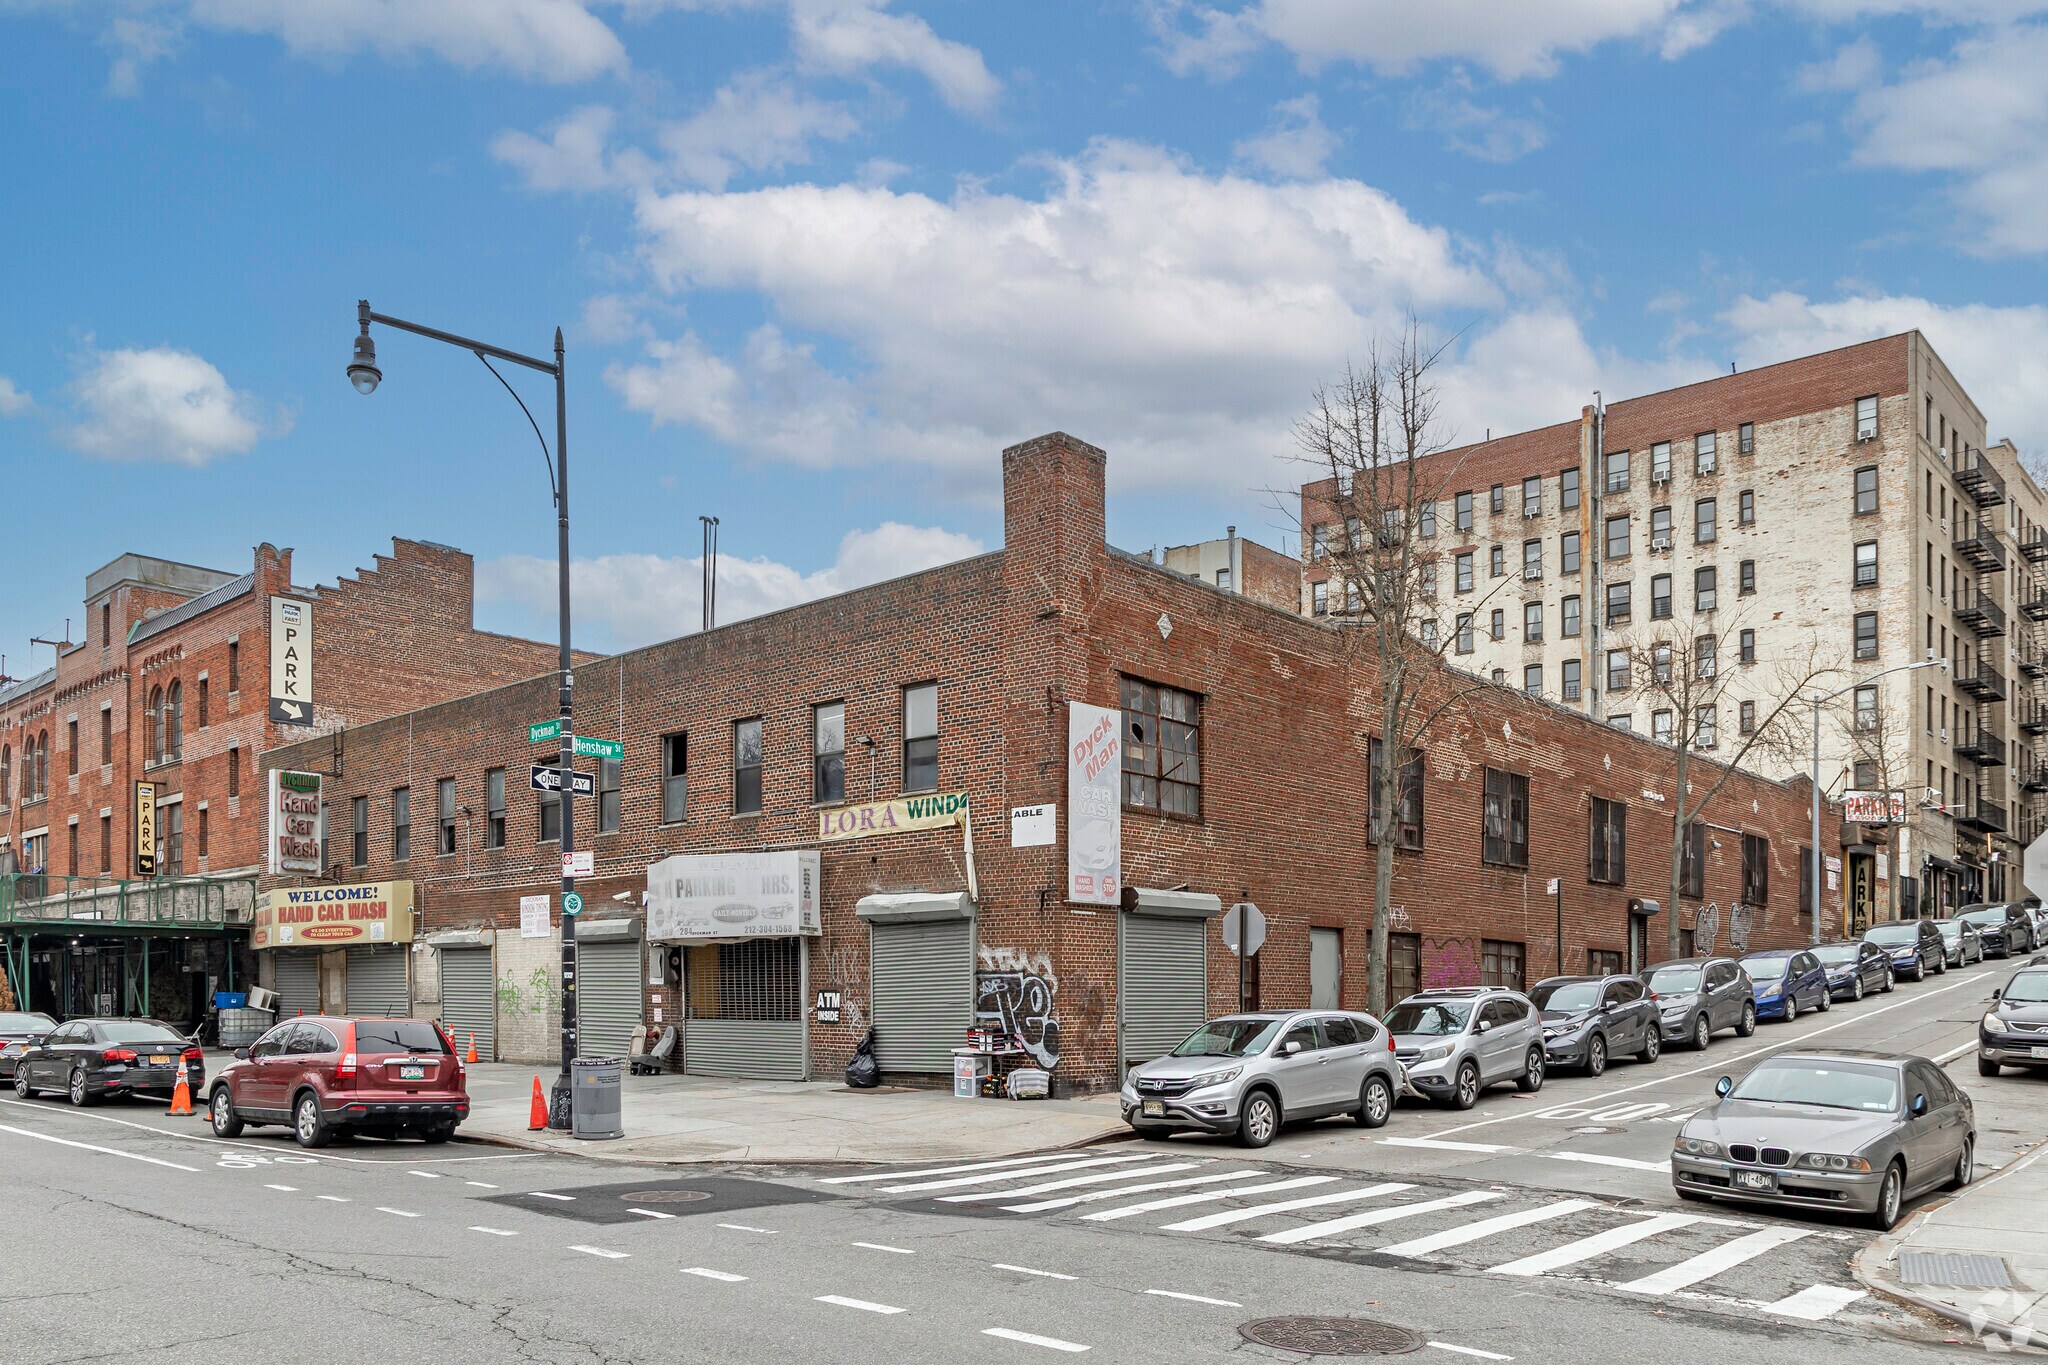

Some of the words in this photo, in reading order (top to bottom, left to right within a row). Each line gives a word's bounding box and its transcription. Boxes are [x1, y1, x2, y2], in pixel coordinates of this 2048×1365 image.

[285, 628, 299, 696] PARK
[531, 725, 555, 741] Dyckman
[1073, 713, 1114, 767] Dyck
[575, 738, 612, 756] Henshaw
[615, 744, 621, 753] St
[1084, 737, 1119, 784] Man
[541, 774, 559, 786] ONE
[573, 779, 586, 789] AY
[280, 791, 320, 815] Hand
[1079, 783, 1112, 802] CAR
[823, 805, 898, 835] LORA
[1072, 799, 1118, 820] WASH
[141, 802, 151, 851] PARK
[285, 814, 315, 836] Car
[280, 835, 320, 858] Wash
[287, 886, 378, 904] WELCOME!
[1103, 883, 1116, 893] STOP
[278, 904, 314, 924] HAND
[317, 903, 345, 922] CAR
[347, 901, 388, 920] WASH
[744, 925, 793, 934] 212-304-1568
[817, 992, 840, 1008] ATM
[817, 1010, 839, 1022] INSIDE
